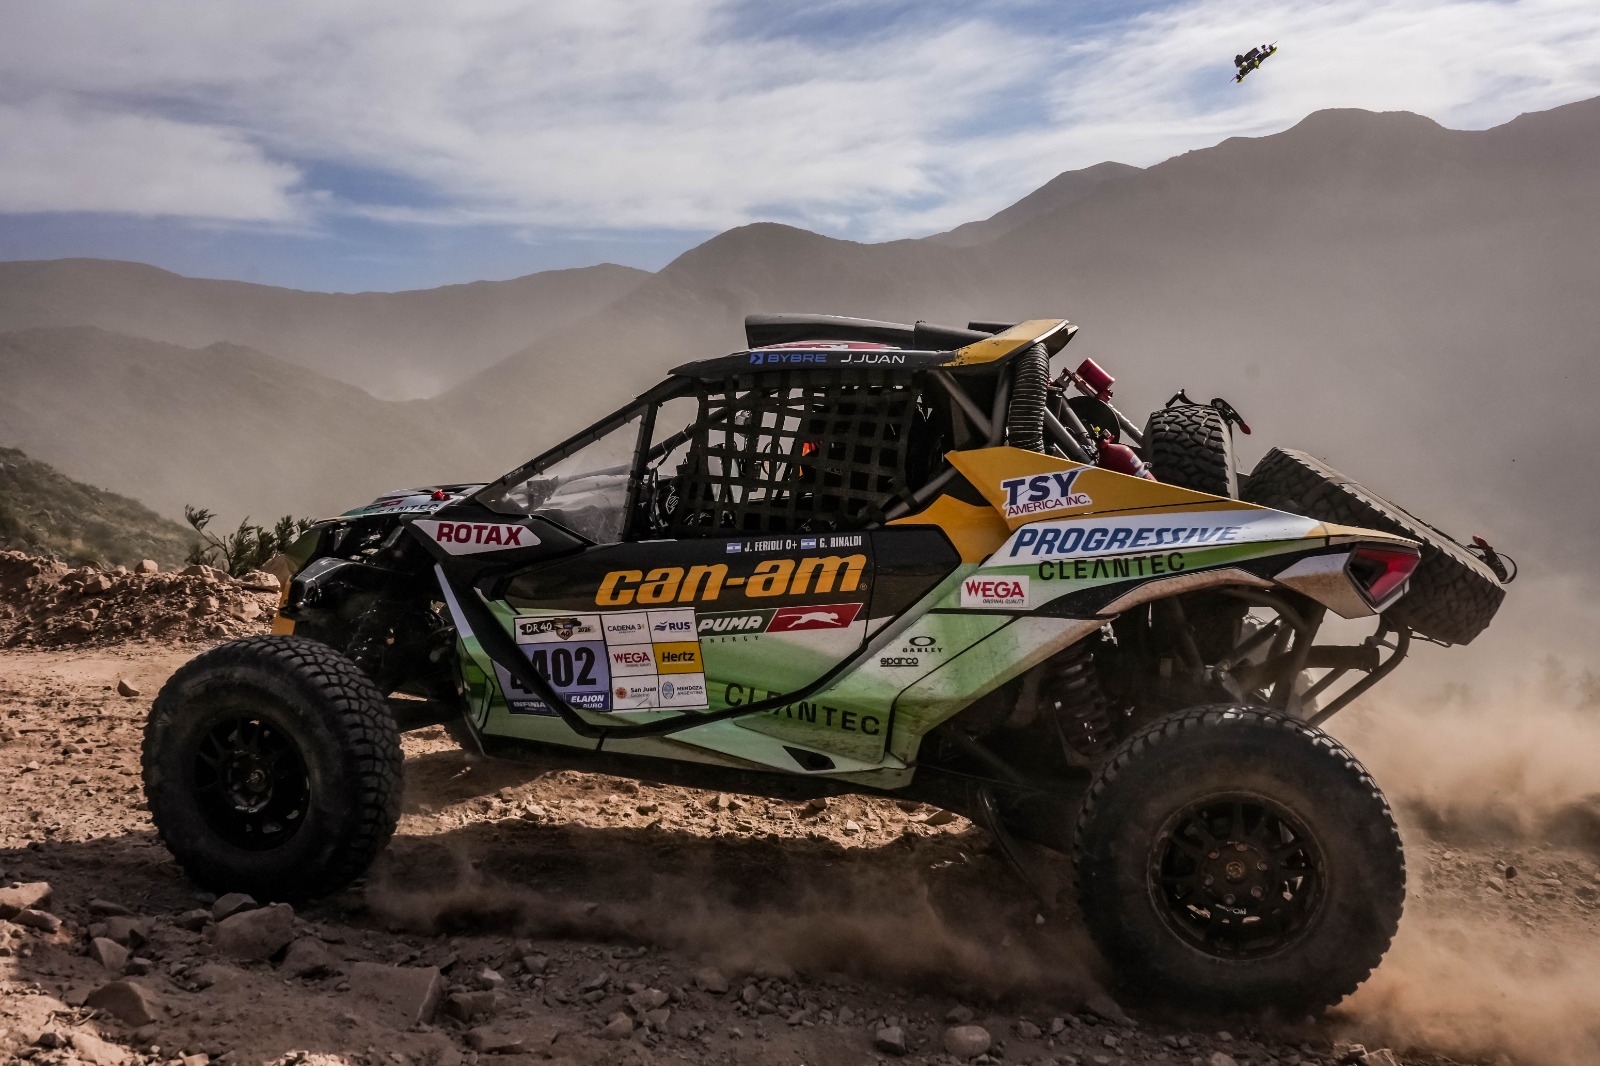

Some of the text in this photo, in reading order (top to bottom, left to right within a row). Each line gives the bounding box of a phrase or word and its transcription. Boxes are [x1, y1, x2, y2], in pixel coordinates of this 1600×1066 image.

[767, 354, 827, 363] BYBRE
[1002, 470, 1079, 506] TSY
[1007, 494, 1090, 516] AMERICA INC.
[436, 523, 524, 546] ROTAX
[744, 541, 752, 552] J.
[754, 540, 783, 552] FERIOLI
[819, 535, 862, 548] G. RINALDI
[1009, 526, 1242, 558] PROGRESSIVE
[1038, 551, 1185, 581] CLEANTEC
[595, 554, 866, 606] can-am
[965, 579, 1025, 599] WEGA
[526, 623, 540, 634] DR
[541, 621, 553, 631] 40
[607, 624, 636, 632] CADENA
[668, 622, 691, 631] RUS
[697, 615, 763, 633] PUMA
[613, 652, 651, 664] WEGA
[662, 651, 695, 662] Hertz
[880, 657, 919, 666] sparco
[570, 694, 605, 703] ELAION
